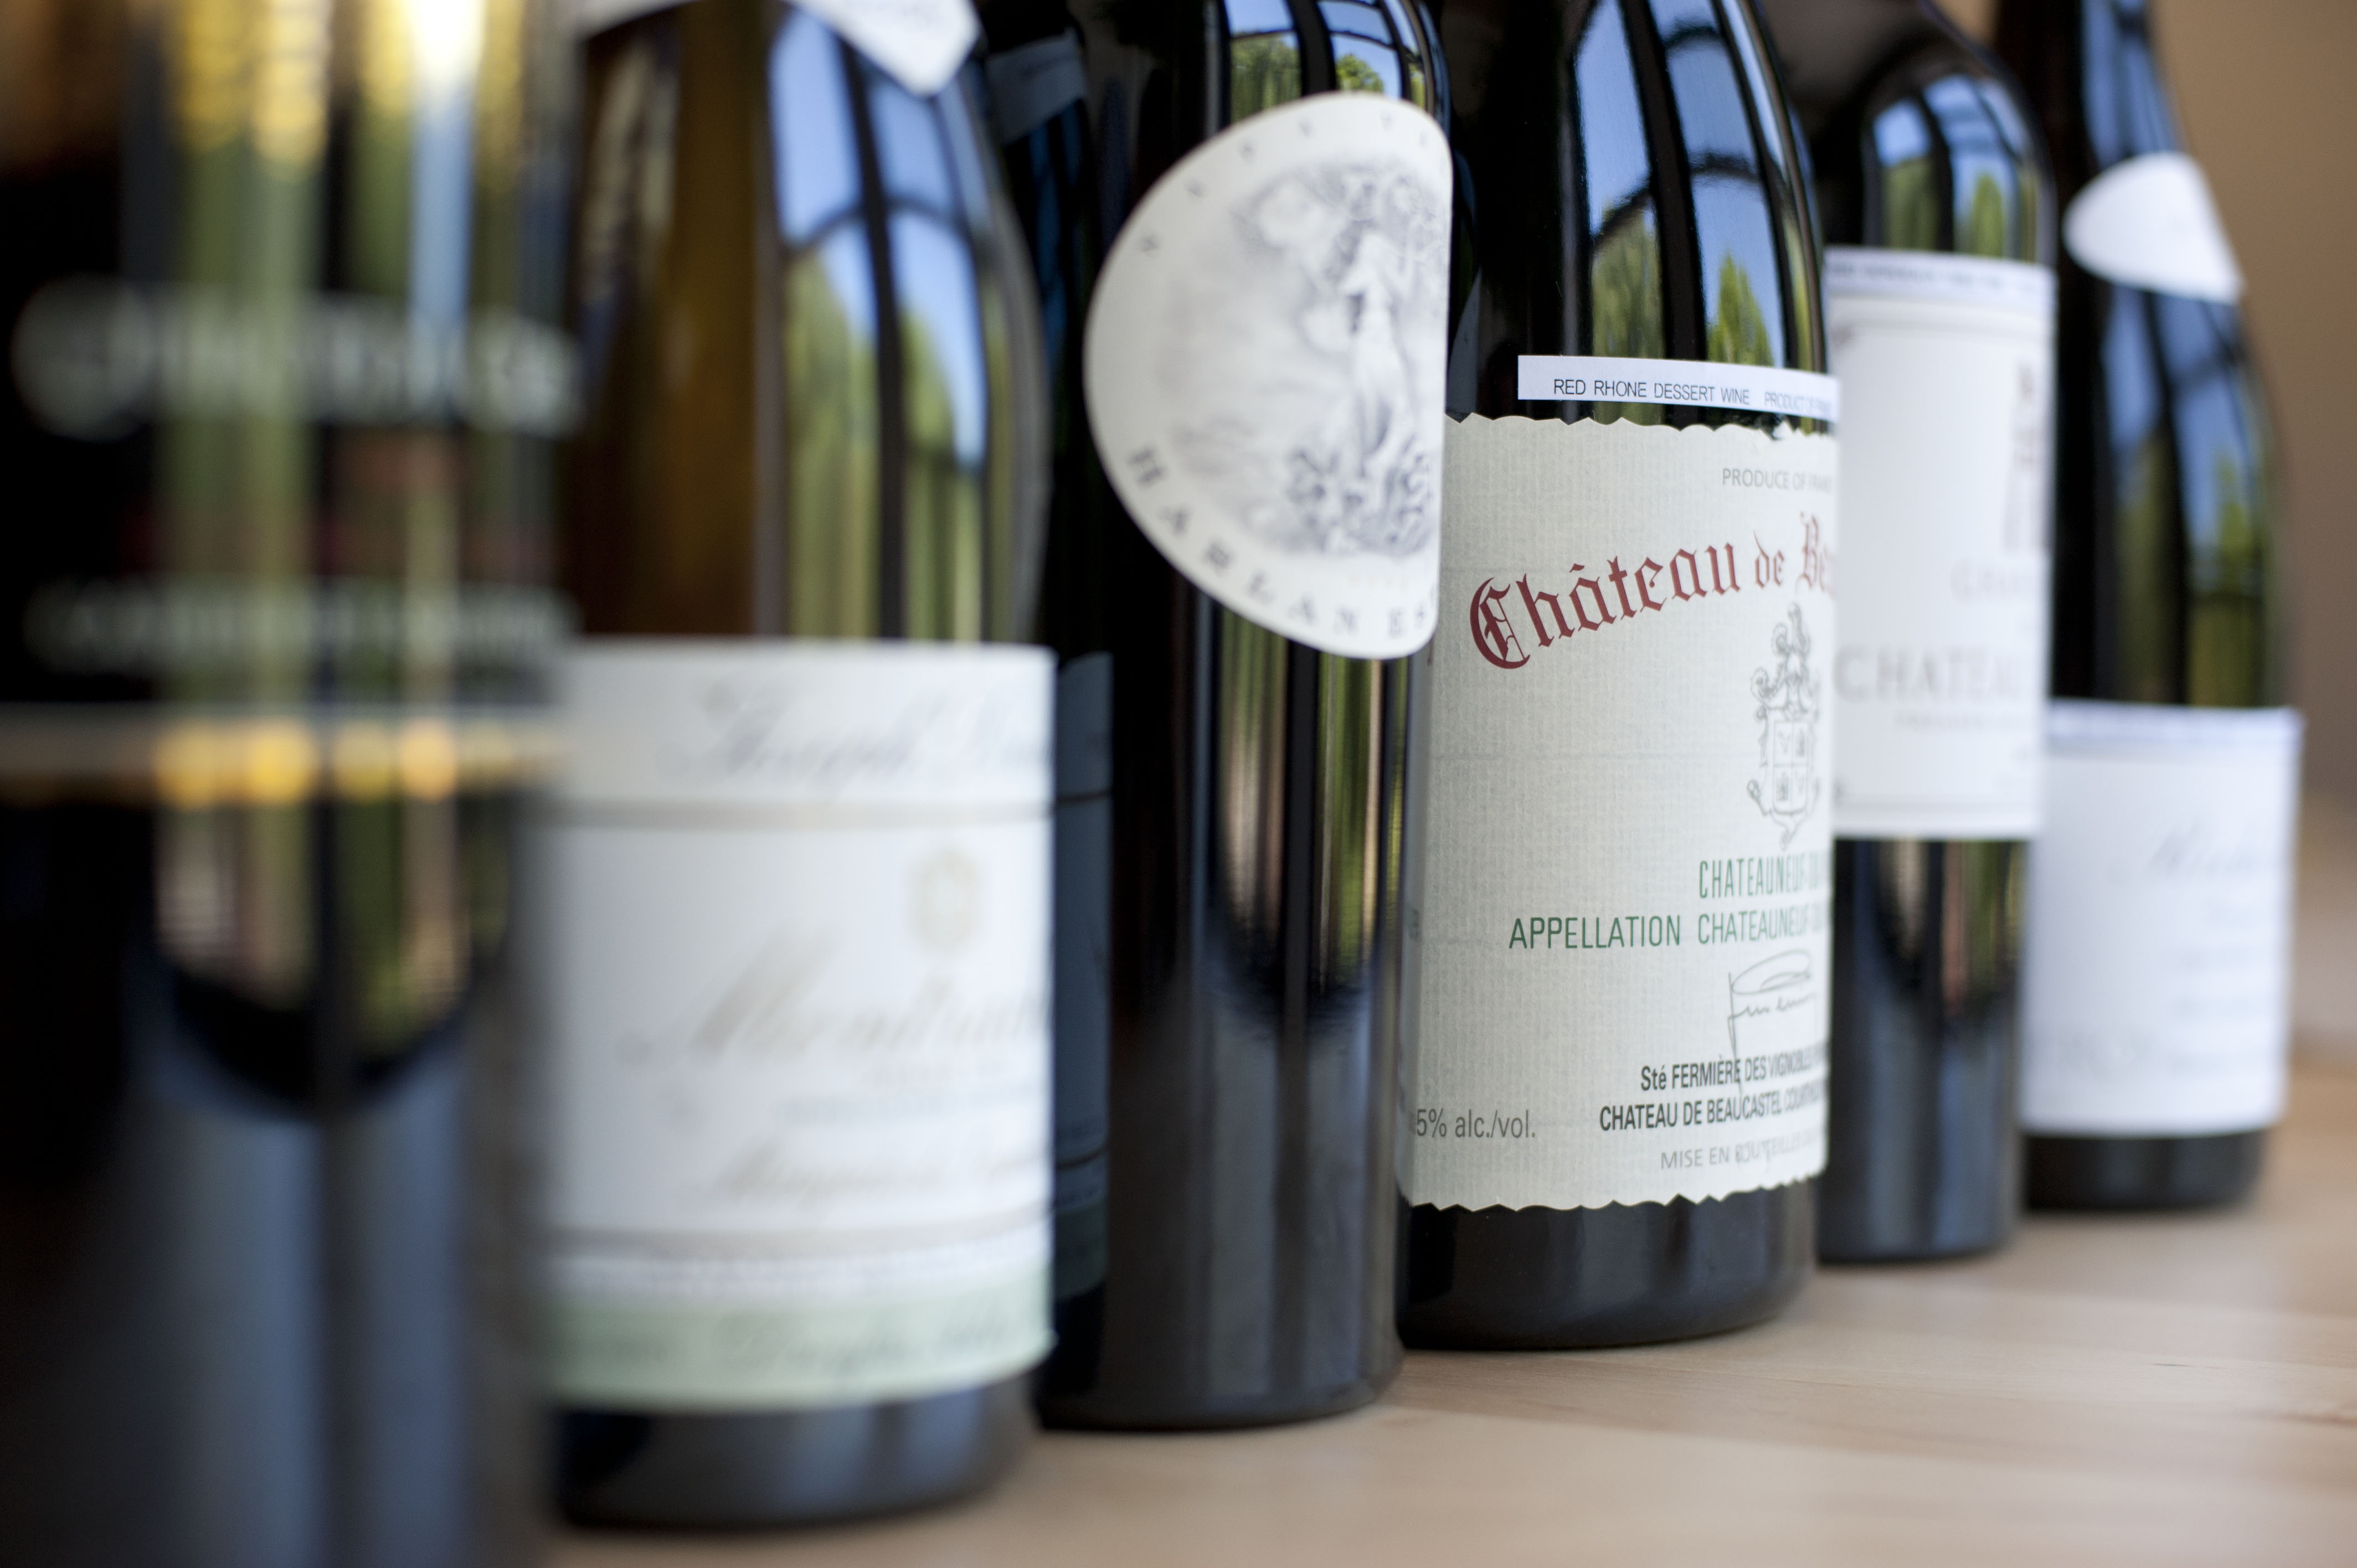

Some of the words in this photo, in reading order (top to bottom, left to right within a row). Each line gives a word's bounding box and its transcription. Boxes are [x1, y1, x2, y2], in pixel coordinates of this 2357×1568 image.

[1553, 378, 1587, 395] RED
[1594, 380, 1647, 398] RHONE
[1654, 382, 1715, 403] DESSERT
[1720, 387, 1750, 406] WINE
[1722, 468, 1790, 490] PRODUCE
[1469, 542, 1741, 669] Château
[1752, 529, 1785, 589] de
[1508, 914, 1682, 950] APPELLATION
[1640, 1064, 1666, 1091] Sté
[1671, 1054, 1741, 1090] FERMIÈRE
[1744, 1055, 1766, 1081] DES
[1416, 1107, 1447, 1138] 5%
[1454, 1108, 1536, 1138] alc./vol.
[1599, 1102, 1677, 1131] CHATEAU
[1683, 1100, 1702, 1126] DE
[1706, 1089, 1782, 1124] BEAUCASTEL
[1660, 1148, 1703, 1170] MISE
[1709, 1146, 1730, 1165] EN
